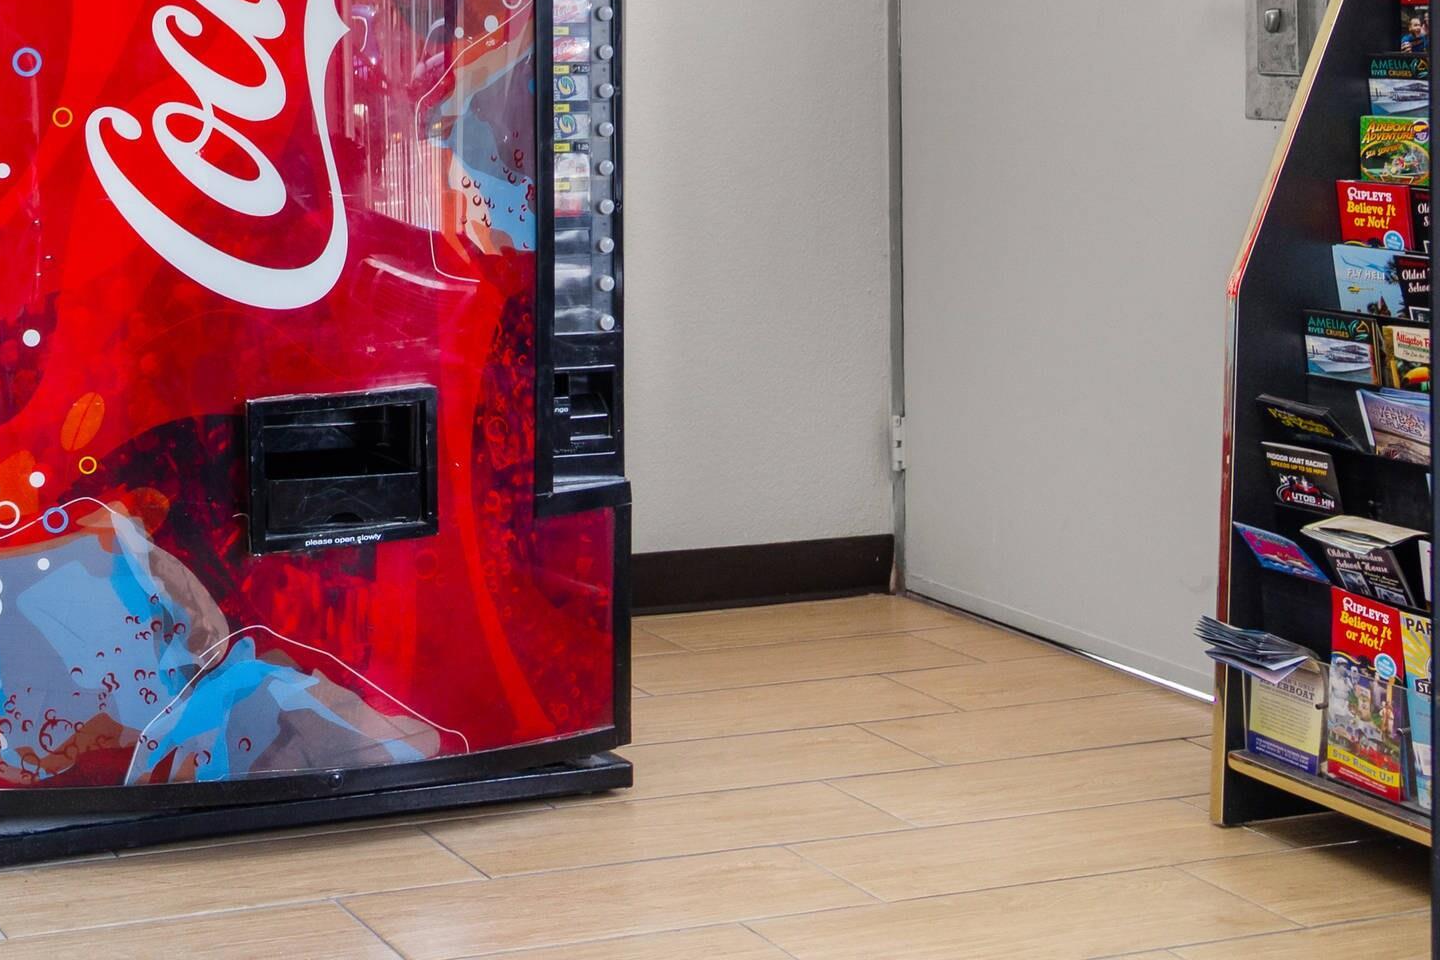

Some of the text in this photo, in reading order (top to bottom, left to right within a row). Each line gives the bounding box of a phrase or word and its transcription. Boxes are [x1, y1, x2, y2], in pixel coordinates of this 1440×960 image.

[1370, 58, 1408, 71] AMELIA
[1347, 186, 1392, 202] RIPLEY'S
[1346, 201, 1396, 217] Believe It
[1354, 215, 1390, 229] or Not!
[1308, 315, 1347, 330] AMELIA
[1308, 326, 1349, 339] RIVER CRUISES
[305, 533, 381, 547] please open slowly
[1354, 552, 1384, 563] Wden
[1342, 596, 1390, 625] RIPLEY'S
[1340, 610, 1392, 641] Believe It
[1345, 630, 1383, 651] or Not!
